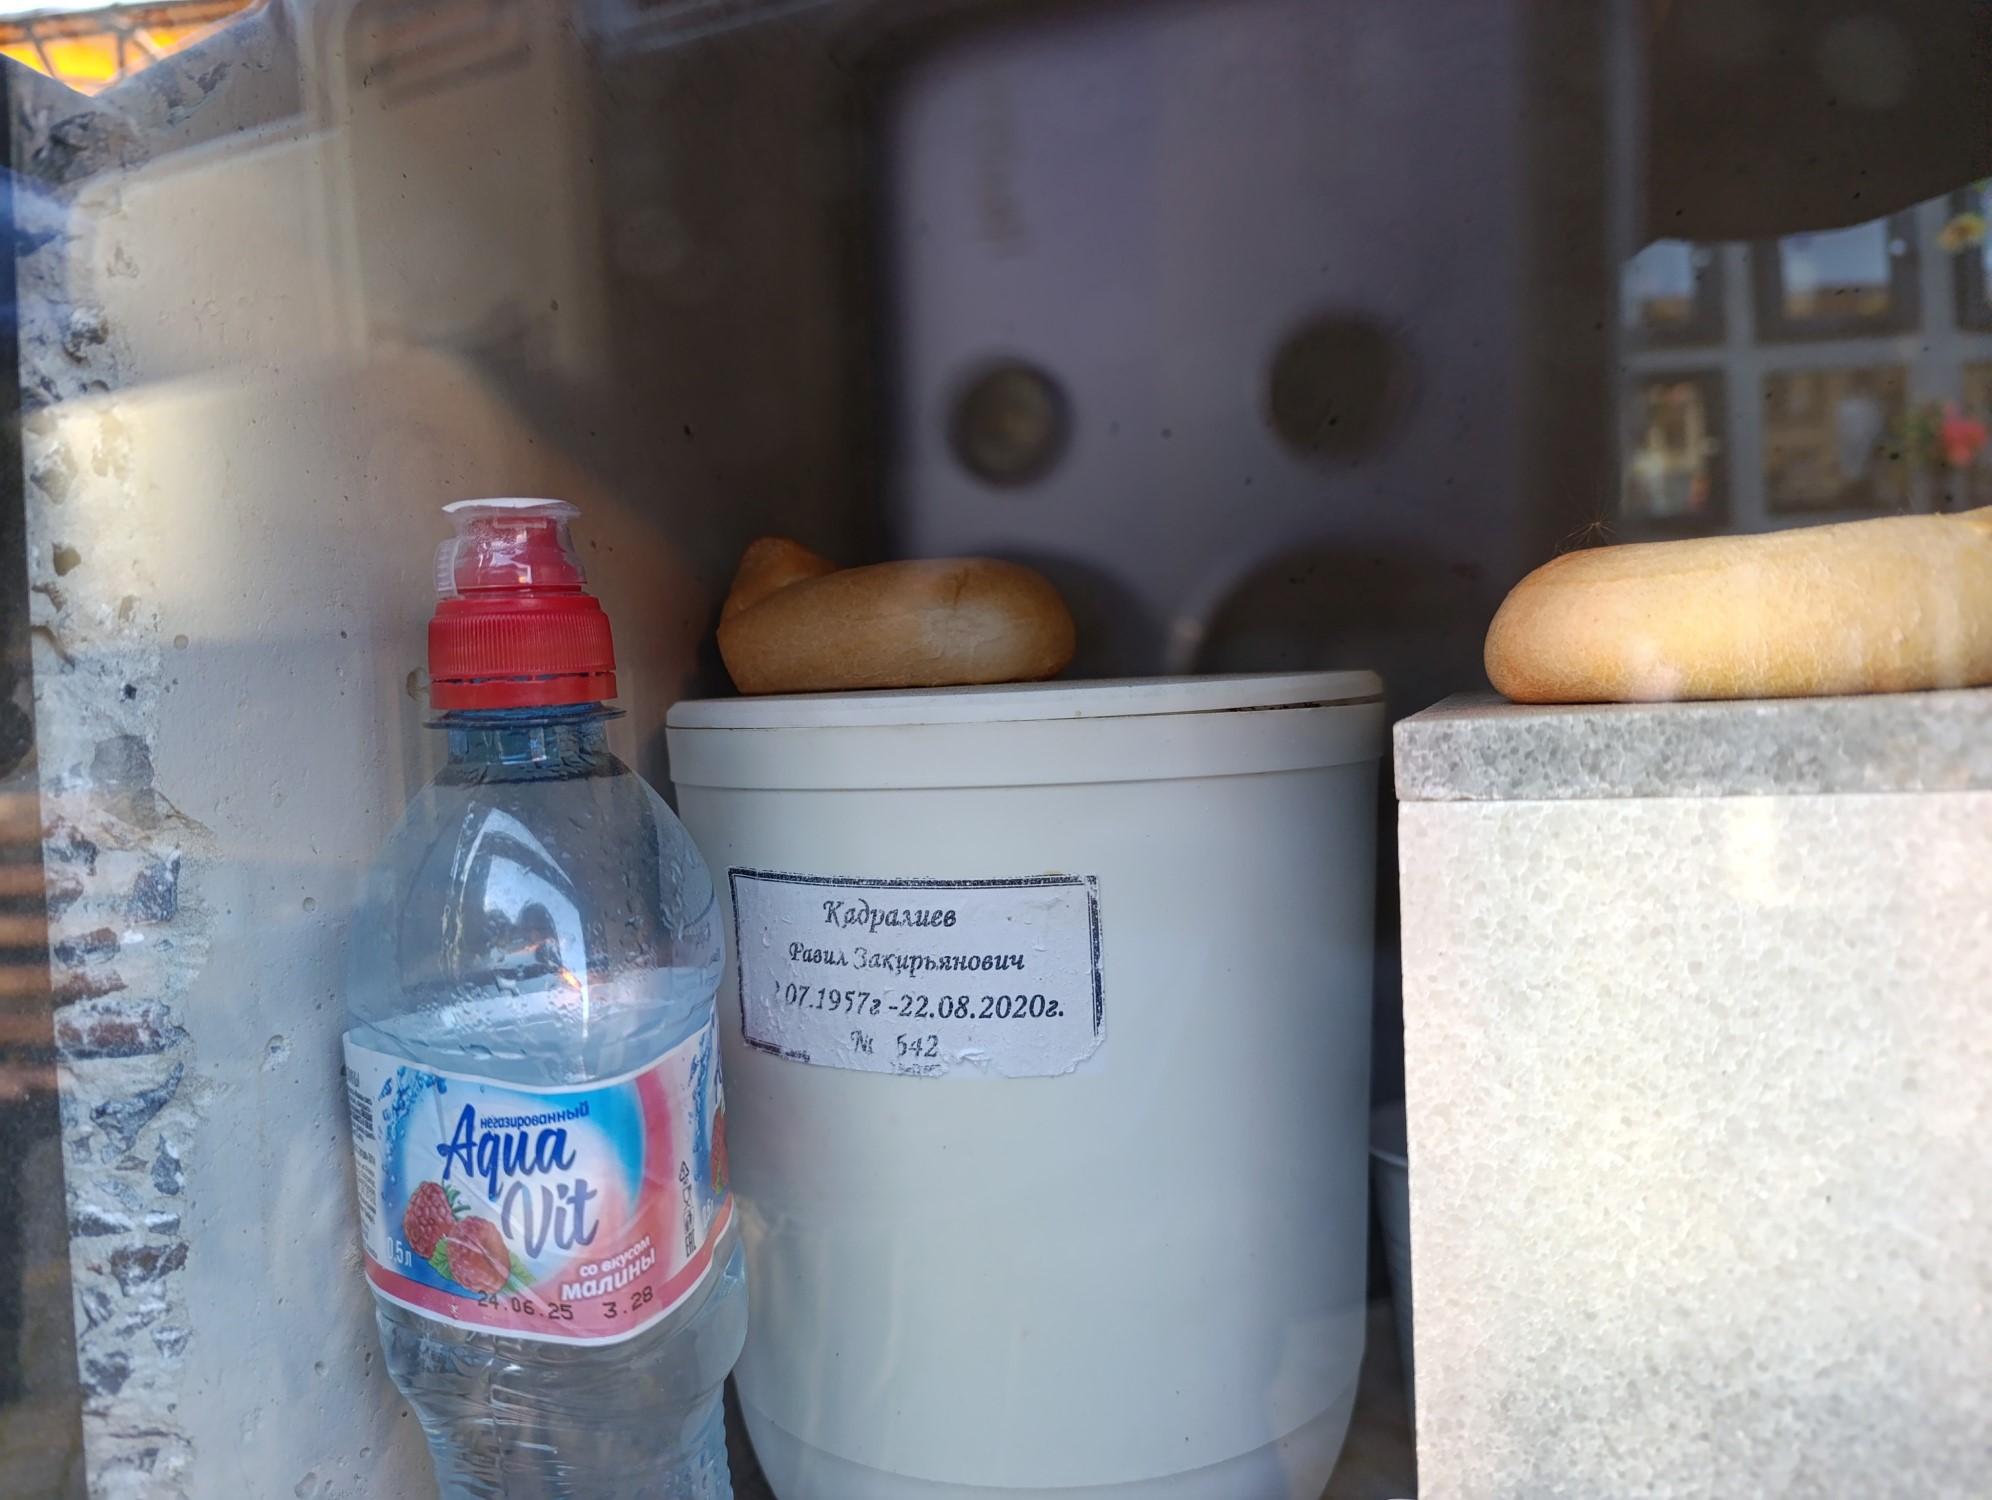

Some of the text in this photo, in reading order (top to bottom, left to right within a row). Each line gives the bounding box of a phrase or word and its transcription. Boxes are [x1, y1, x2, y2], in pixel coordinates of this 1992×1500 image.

[822, 898, 957, 933] Кадралиев
[789, 942, 1025, 978] Равил Закирьянович
[896, 1033, 940, 1058] 542
[479, 1100, 590, 1131] негазированный
[436, 1103, 577, 1202] Aqua
[500, 1178, 600, 1260] Vit
[579, 1235, 651, 1277] со вкусом
[561, 1249, 656, 1301] малины
[477, 1289, 575, 1321] 24.06.25
